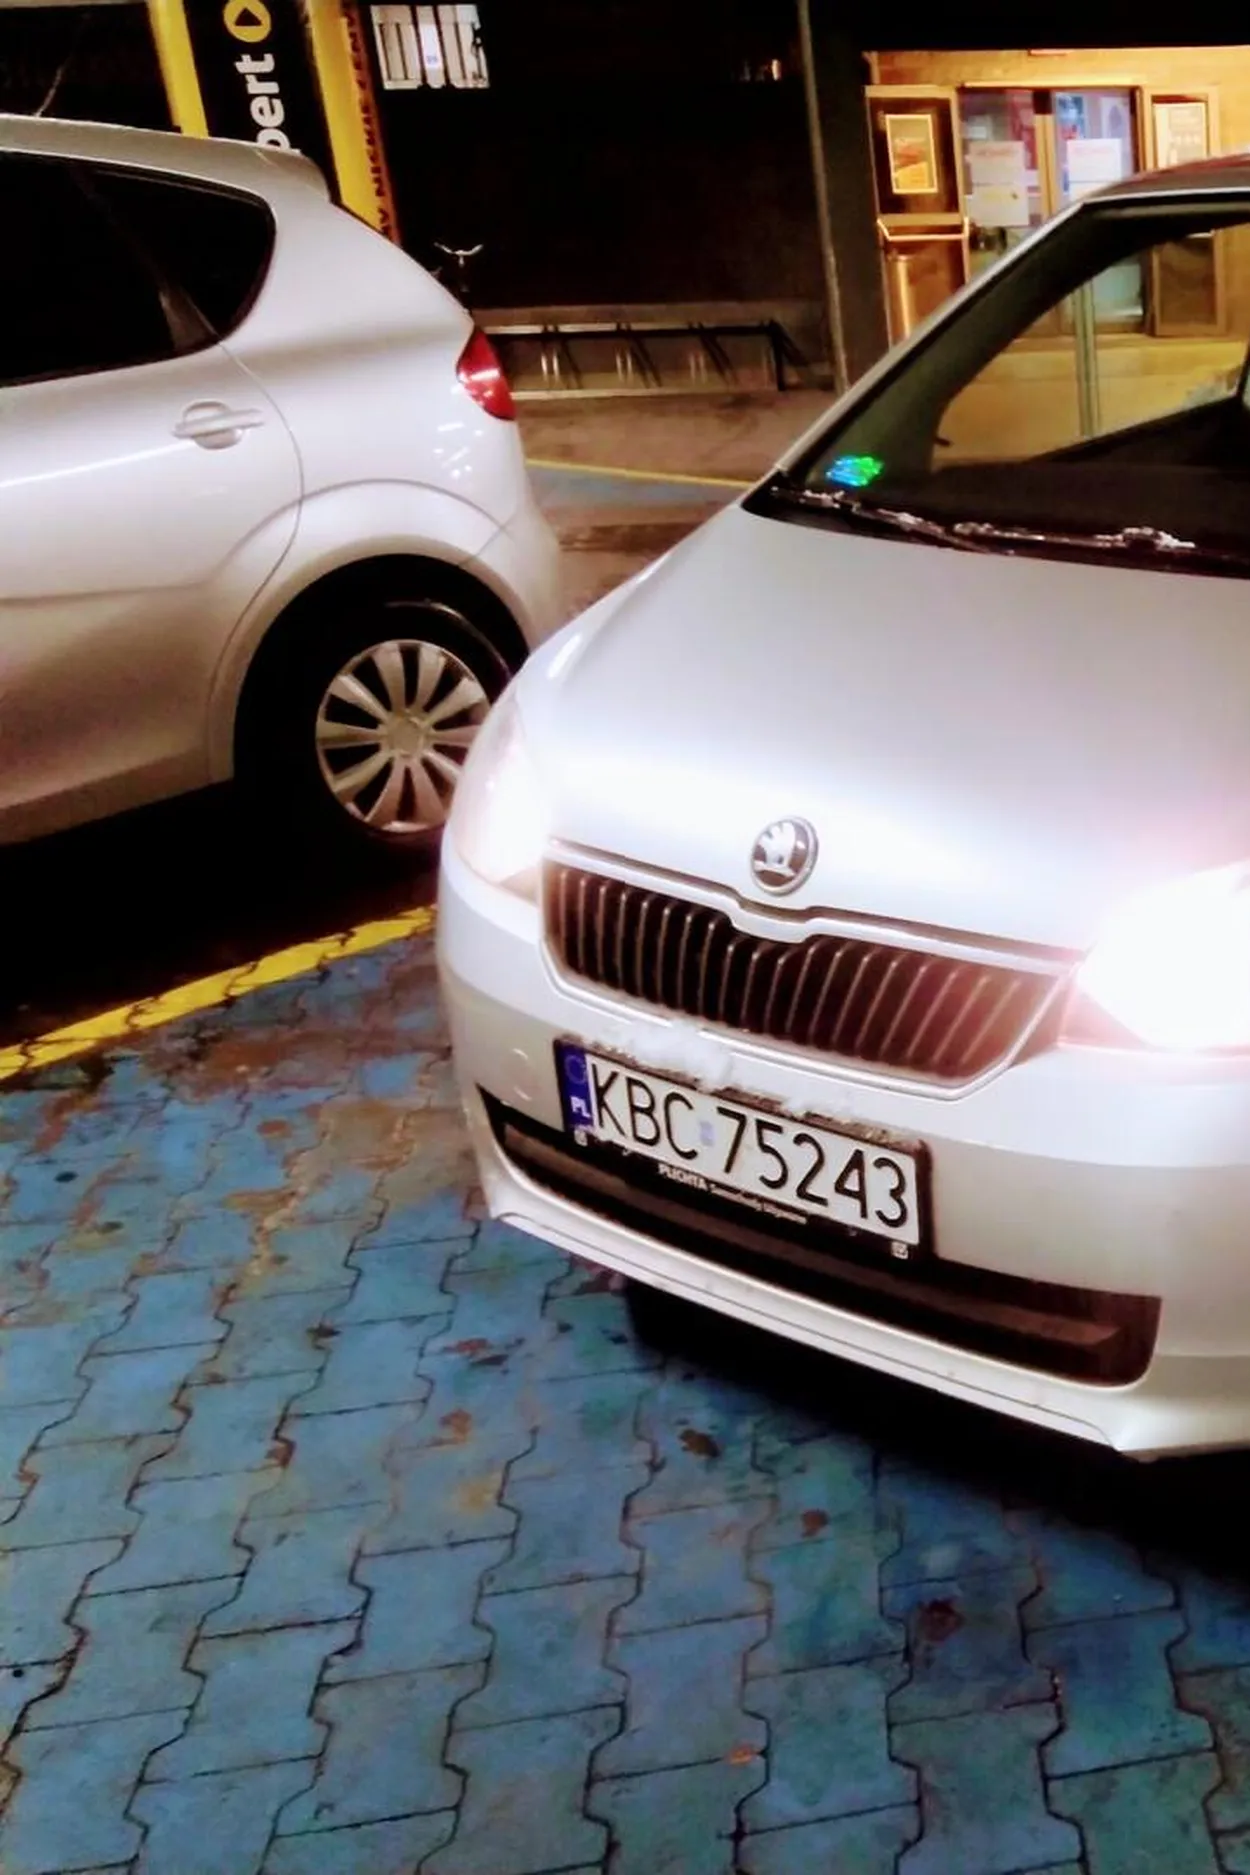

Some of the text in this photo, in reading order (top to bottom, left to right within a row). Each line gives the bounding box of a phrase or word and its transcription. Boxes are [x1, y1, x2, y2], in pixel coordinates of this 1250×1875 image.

[570, 1095, 592, 1119] PL
[590, 1062, 909, 1229] KBC 75243
